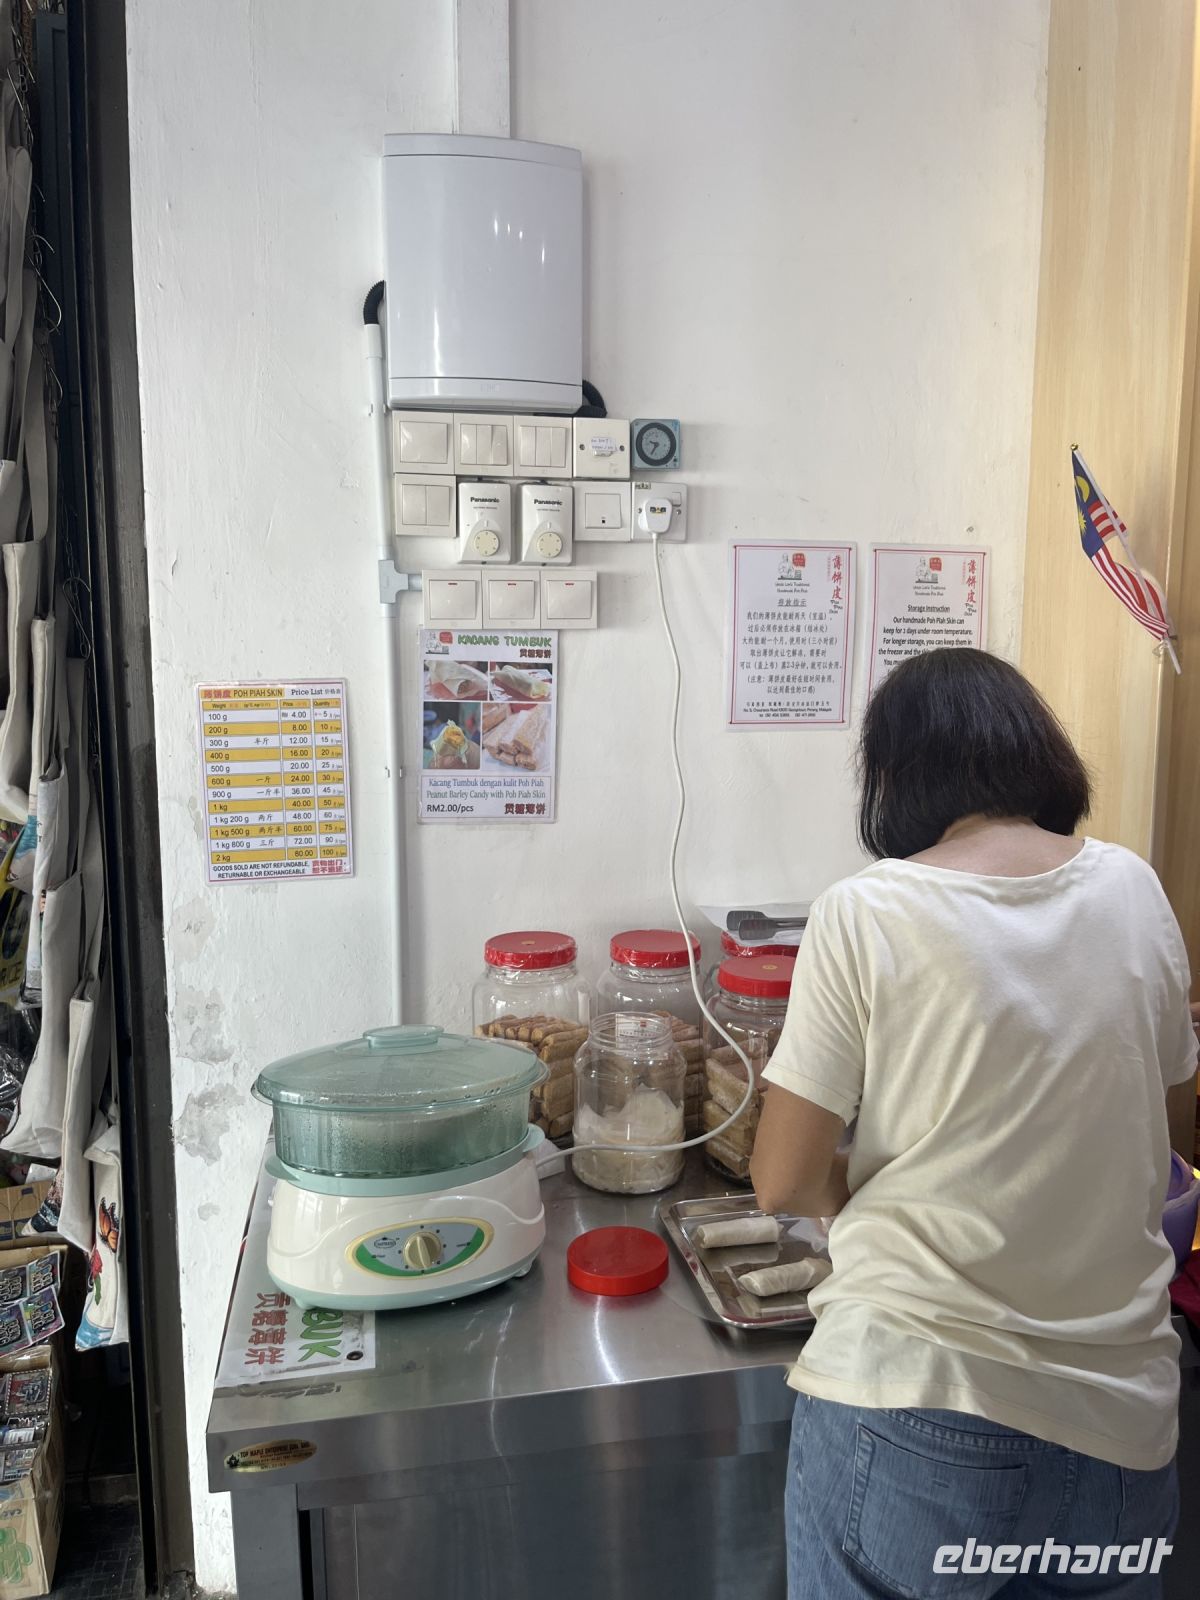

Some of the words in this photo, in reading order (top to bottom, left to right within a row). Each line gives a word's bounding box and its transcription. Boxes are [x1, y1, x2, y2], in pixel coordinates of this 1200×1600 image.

[908, 605, 925, 613] Storage
[883, 627, 894, 635] keep
[504, 636, 552, 647] TUMBUK
[892, 638, 906, 646] longer
[233, 689, 249, 697] POH
[249, 689, 266, 697] PIAH
[267, 688, 283, 697] SKIN
[429, 779, 451, 788] Kacang
[480, 779, 501, 788] dengan
[450, 791, 469, 800] Barley
[470, 791, 489, 800] Candy
[427, 804, 474, 813] RM2.00/pcs
